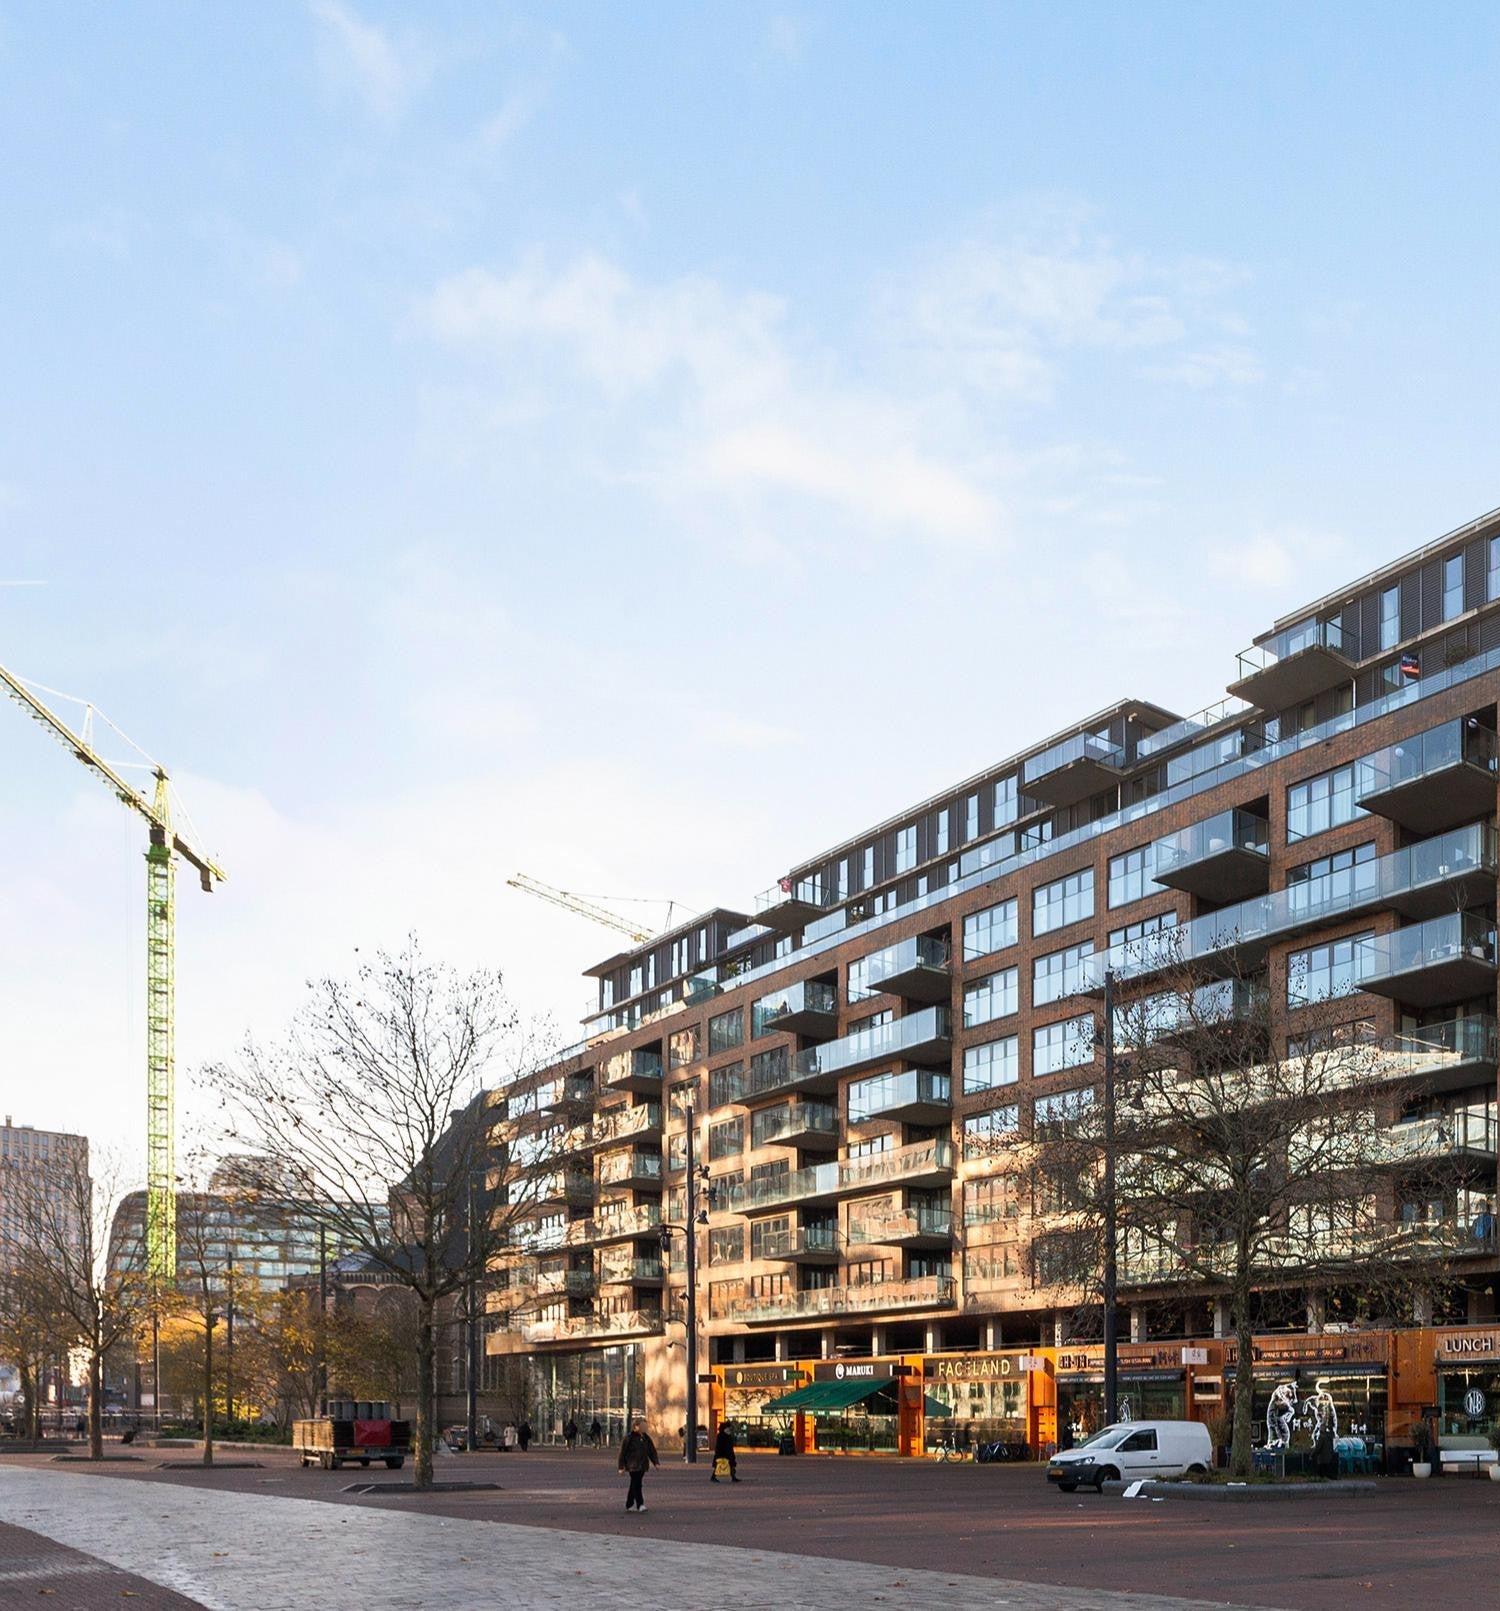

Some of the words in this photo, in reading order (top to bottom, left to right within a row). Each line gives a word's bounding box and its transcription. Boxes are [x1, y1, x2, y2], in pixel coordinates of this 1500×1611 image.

[1445, 1338, 1492, 1352] LUNCH
[845, 1365, 874, 1376] MARUKI
[938, 1359, 1011, 1377] FACELAND
